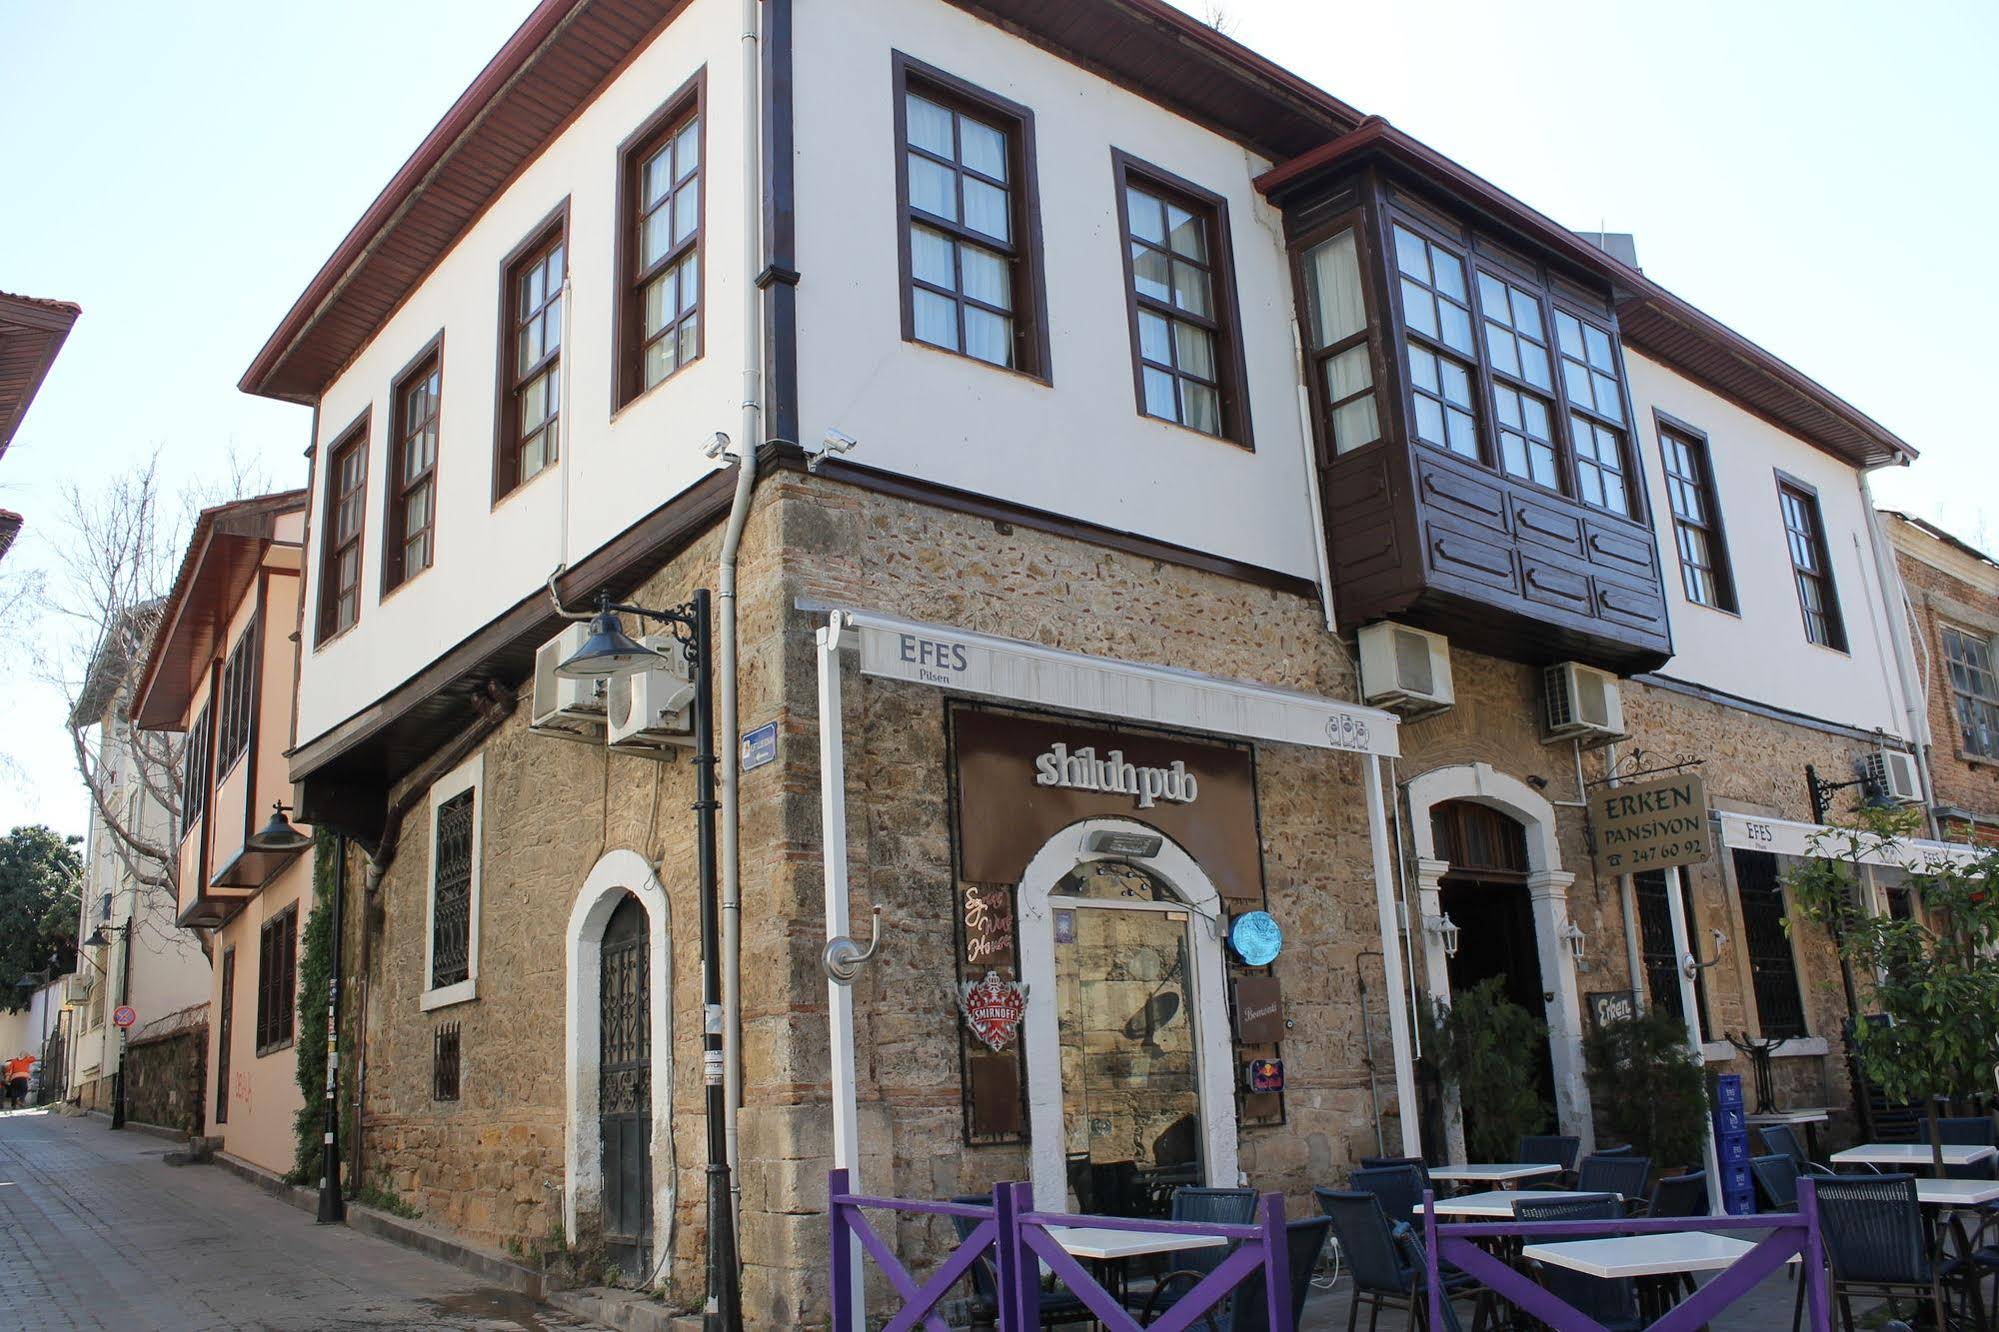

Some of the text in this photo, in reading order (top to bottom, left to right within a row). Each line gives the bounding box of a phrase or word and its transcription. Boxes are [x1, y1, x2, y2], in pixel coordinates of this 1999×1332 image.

[899, 633, 968, 672] EFES
[919, 668, 950, 684] Pilsen
[1605, 784, 1692, 819] ERKEN
[1746, 822, 1772, 842] EFES
[1632, 839, 1701, 863] 247 60 92
[974, 1008, 1016, 1020] SMIRNOFF
